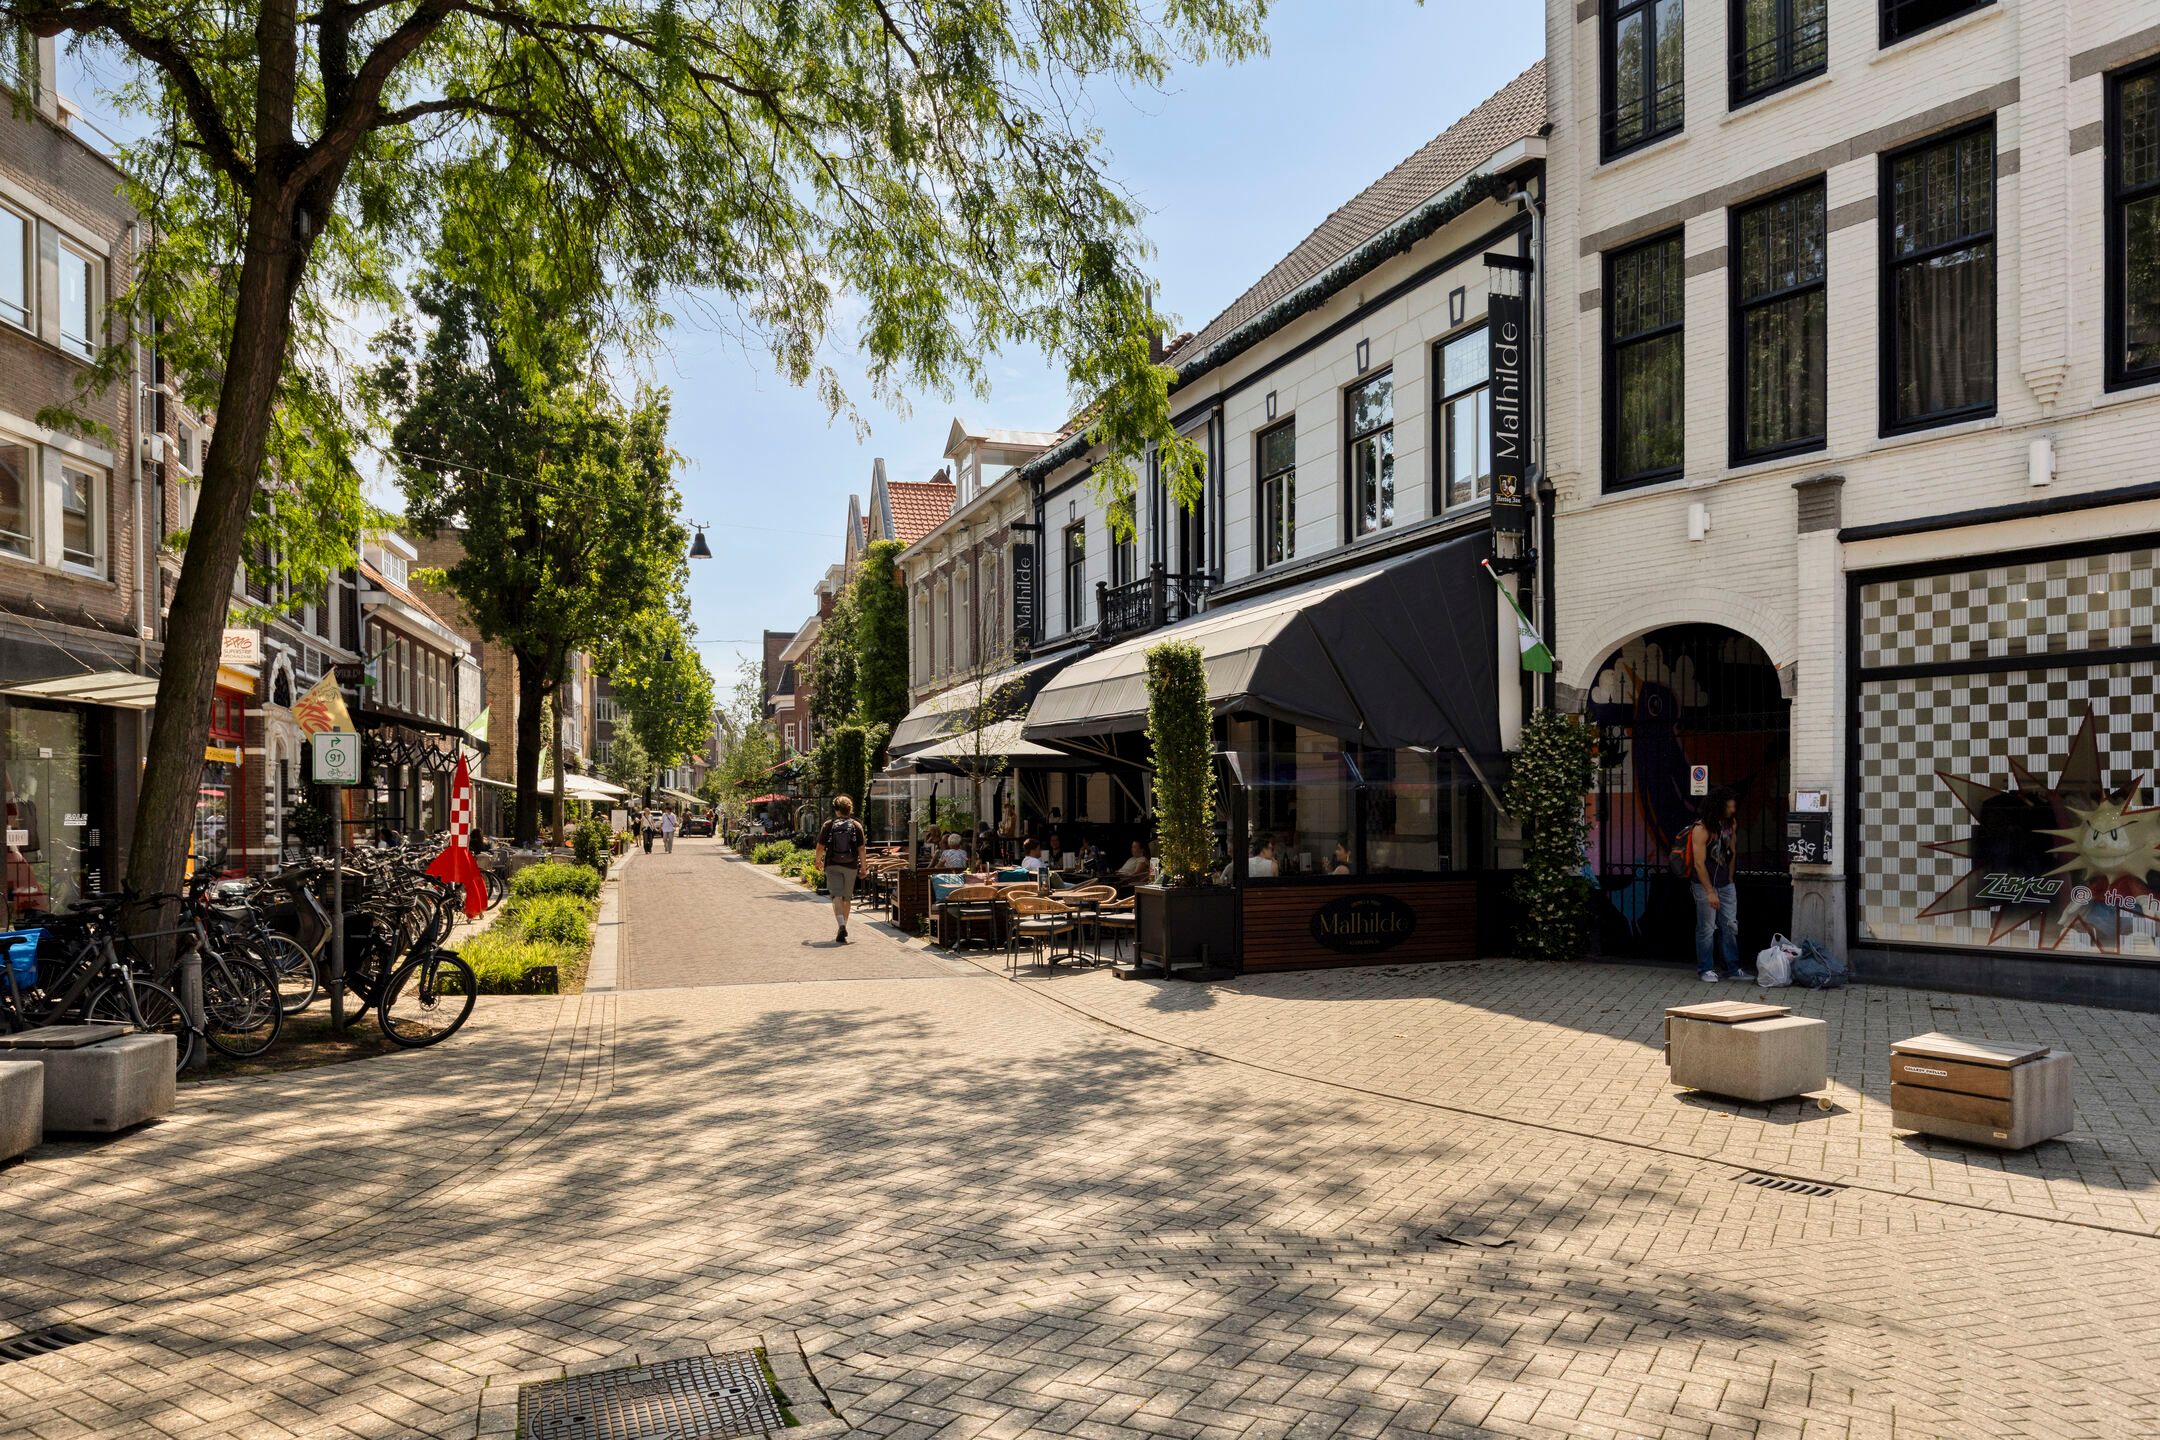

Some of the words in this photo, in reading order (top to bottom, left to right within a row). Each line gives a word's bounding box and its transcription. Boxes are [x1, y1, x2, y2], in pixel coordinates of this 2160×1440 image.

[1495, 321, 1520, 460] Mathilde
[329, 753, 341, 763] 91
[2070, 885, 2093, 905] @
[2104, 888, 2137, 910] the
